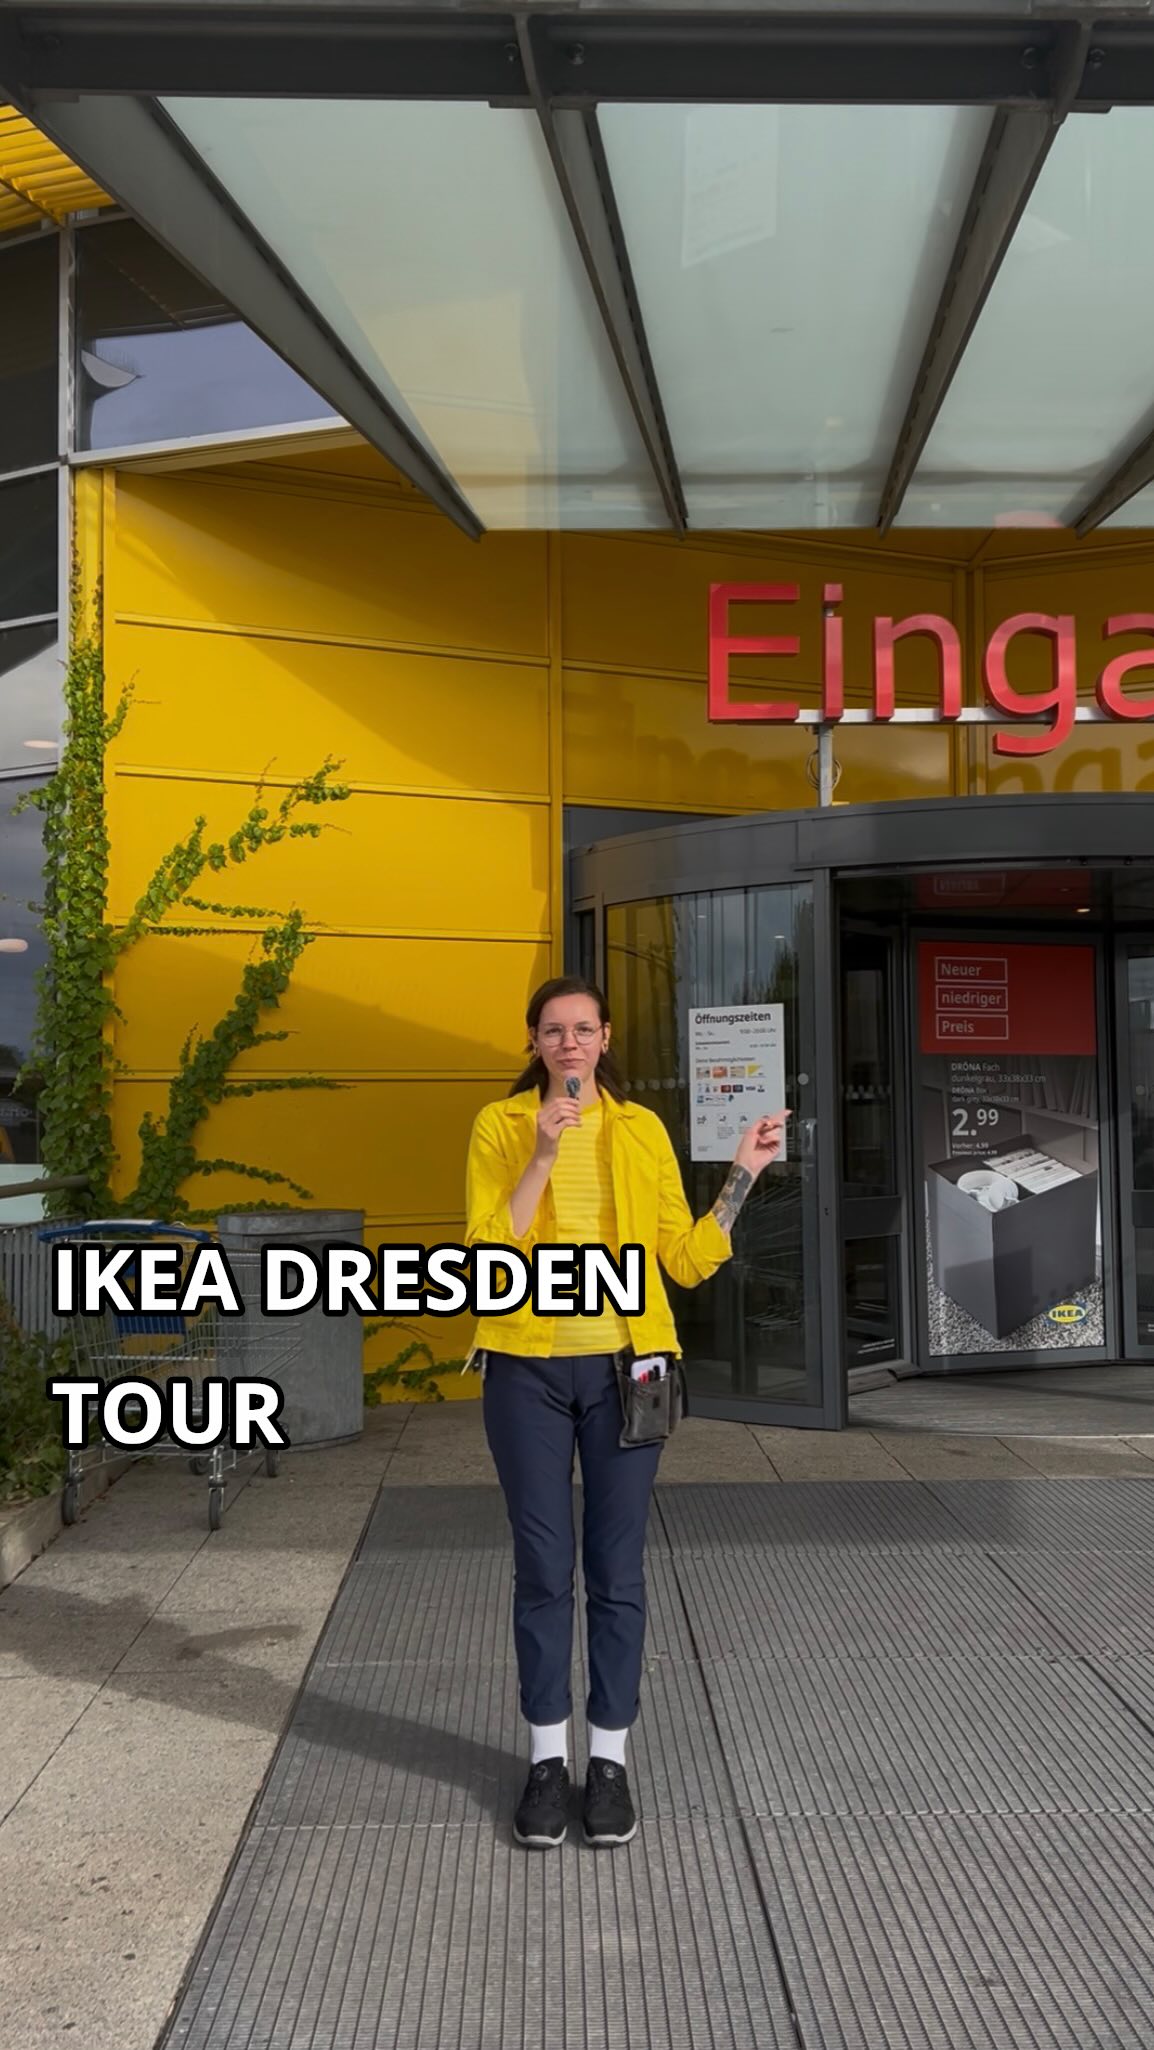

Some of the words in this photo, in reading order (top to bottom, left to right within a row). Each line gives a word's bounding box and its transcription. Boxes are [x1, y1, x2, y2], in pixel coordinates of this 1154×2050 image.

[707, 583, 1154, 757] Einga
[941, 963, 982, 976] Neuer
[941, 991, 1002, 1008] niedriger
[695, 1011, 771, 1025] Öffnungszeiten
[942, 1020, 975, 1033] Preis
[951, 1061, 981, 1071] DRÖNA
[952, 1108, 999, 1136] 2.99
[1051, 1309, 1084, 1318] IKEA
